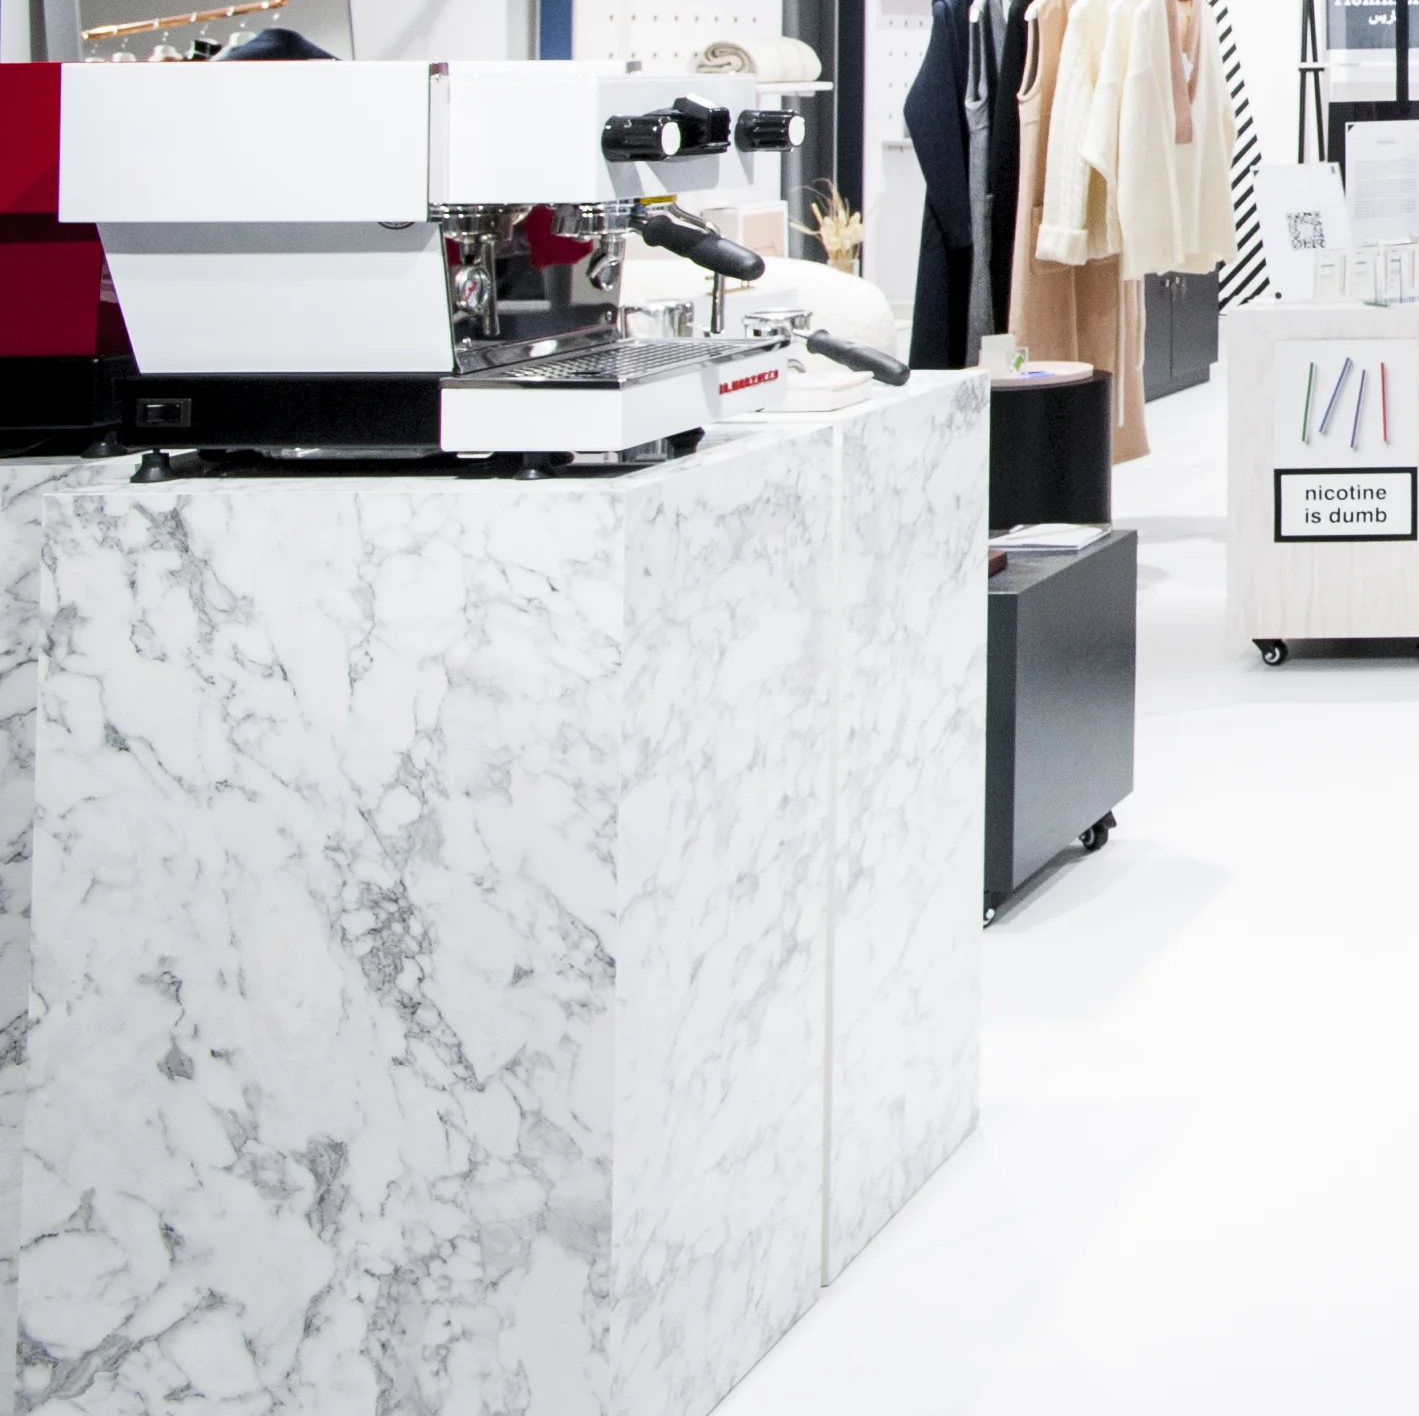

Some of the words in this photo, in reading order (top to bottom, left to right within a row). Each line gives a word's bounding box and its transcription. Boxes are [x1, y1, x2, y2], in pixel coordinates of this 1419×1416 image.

[1305, 484, 1387, 501] nicotine
[1305, 507, 1322, 524] is
[1329, 507, 1388, 524] dumb
